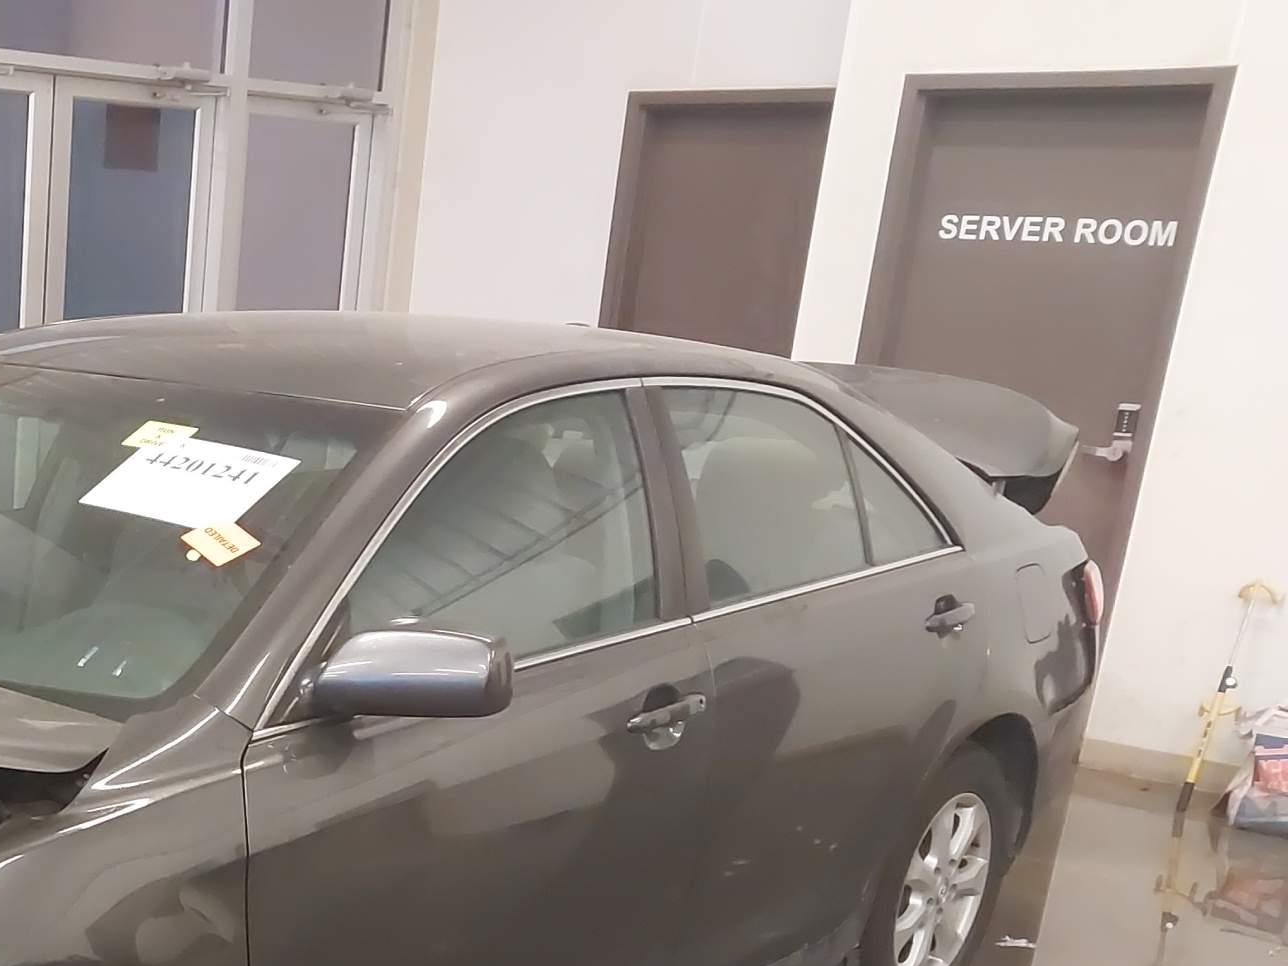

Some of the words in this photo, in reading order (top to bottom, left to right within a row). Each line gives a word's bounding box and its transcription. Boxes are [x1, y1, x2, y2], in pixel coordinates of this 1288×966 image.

[938, 213, 1065, 243] SERVER
[1073, 217, 1178, 247] ROOM
[146, 452, 260, 485] 44201241
[204, 527, 240, 553] DETAILED
